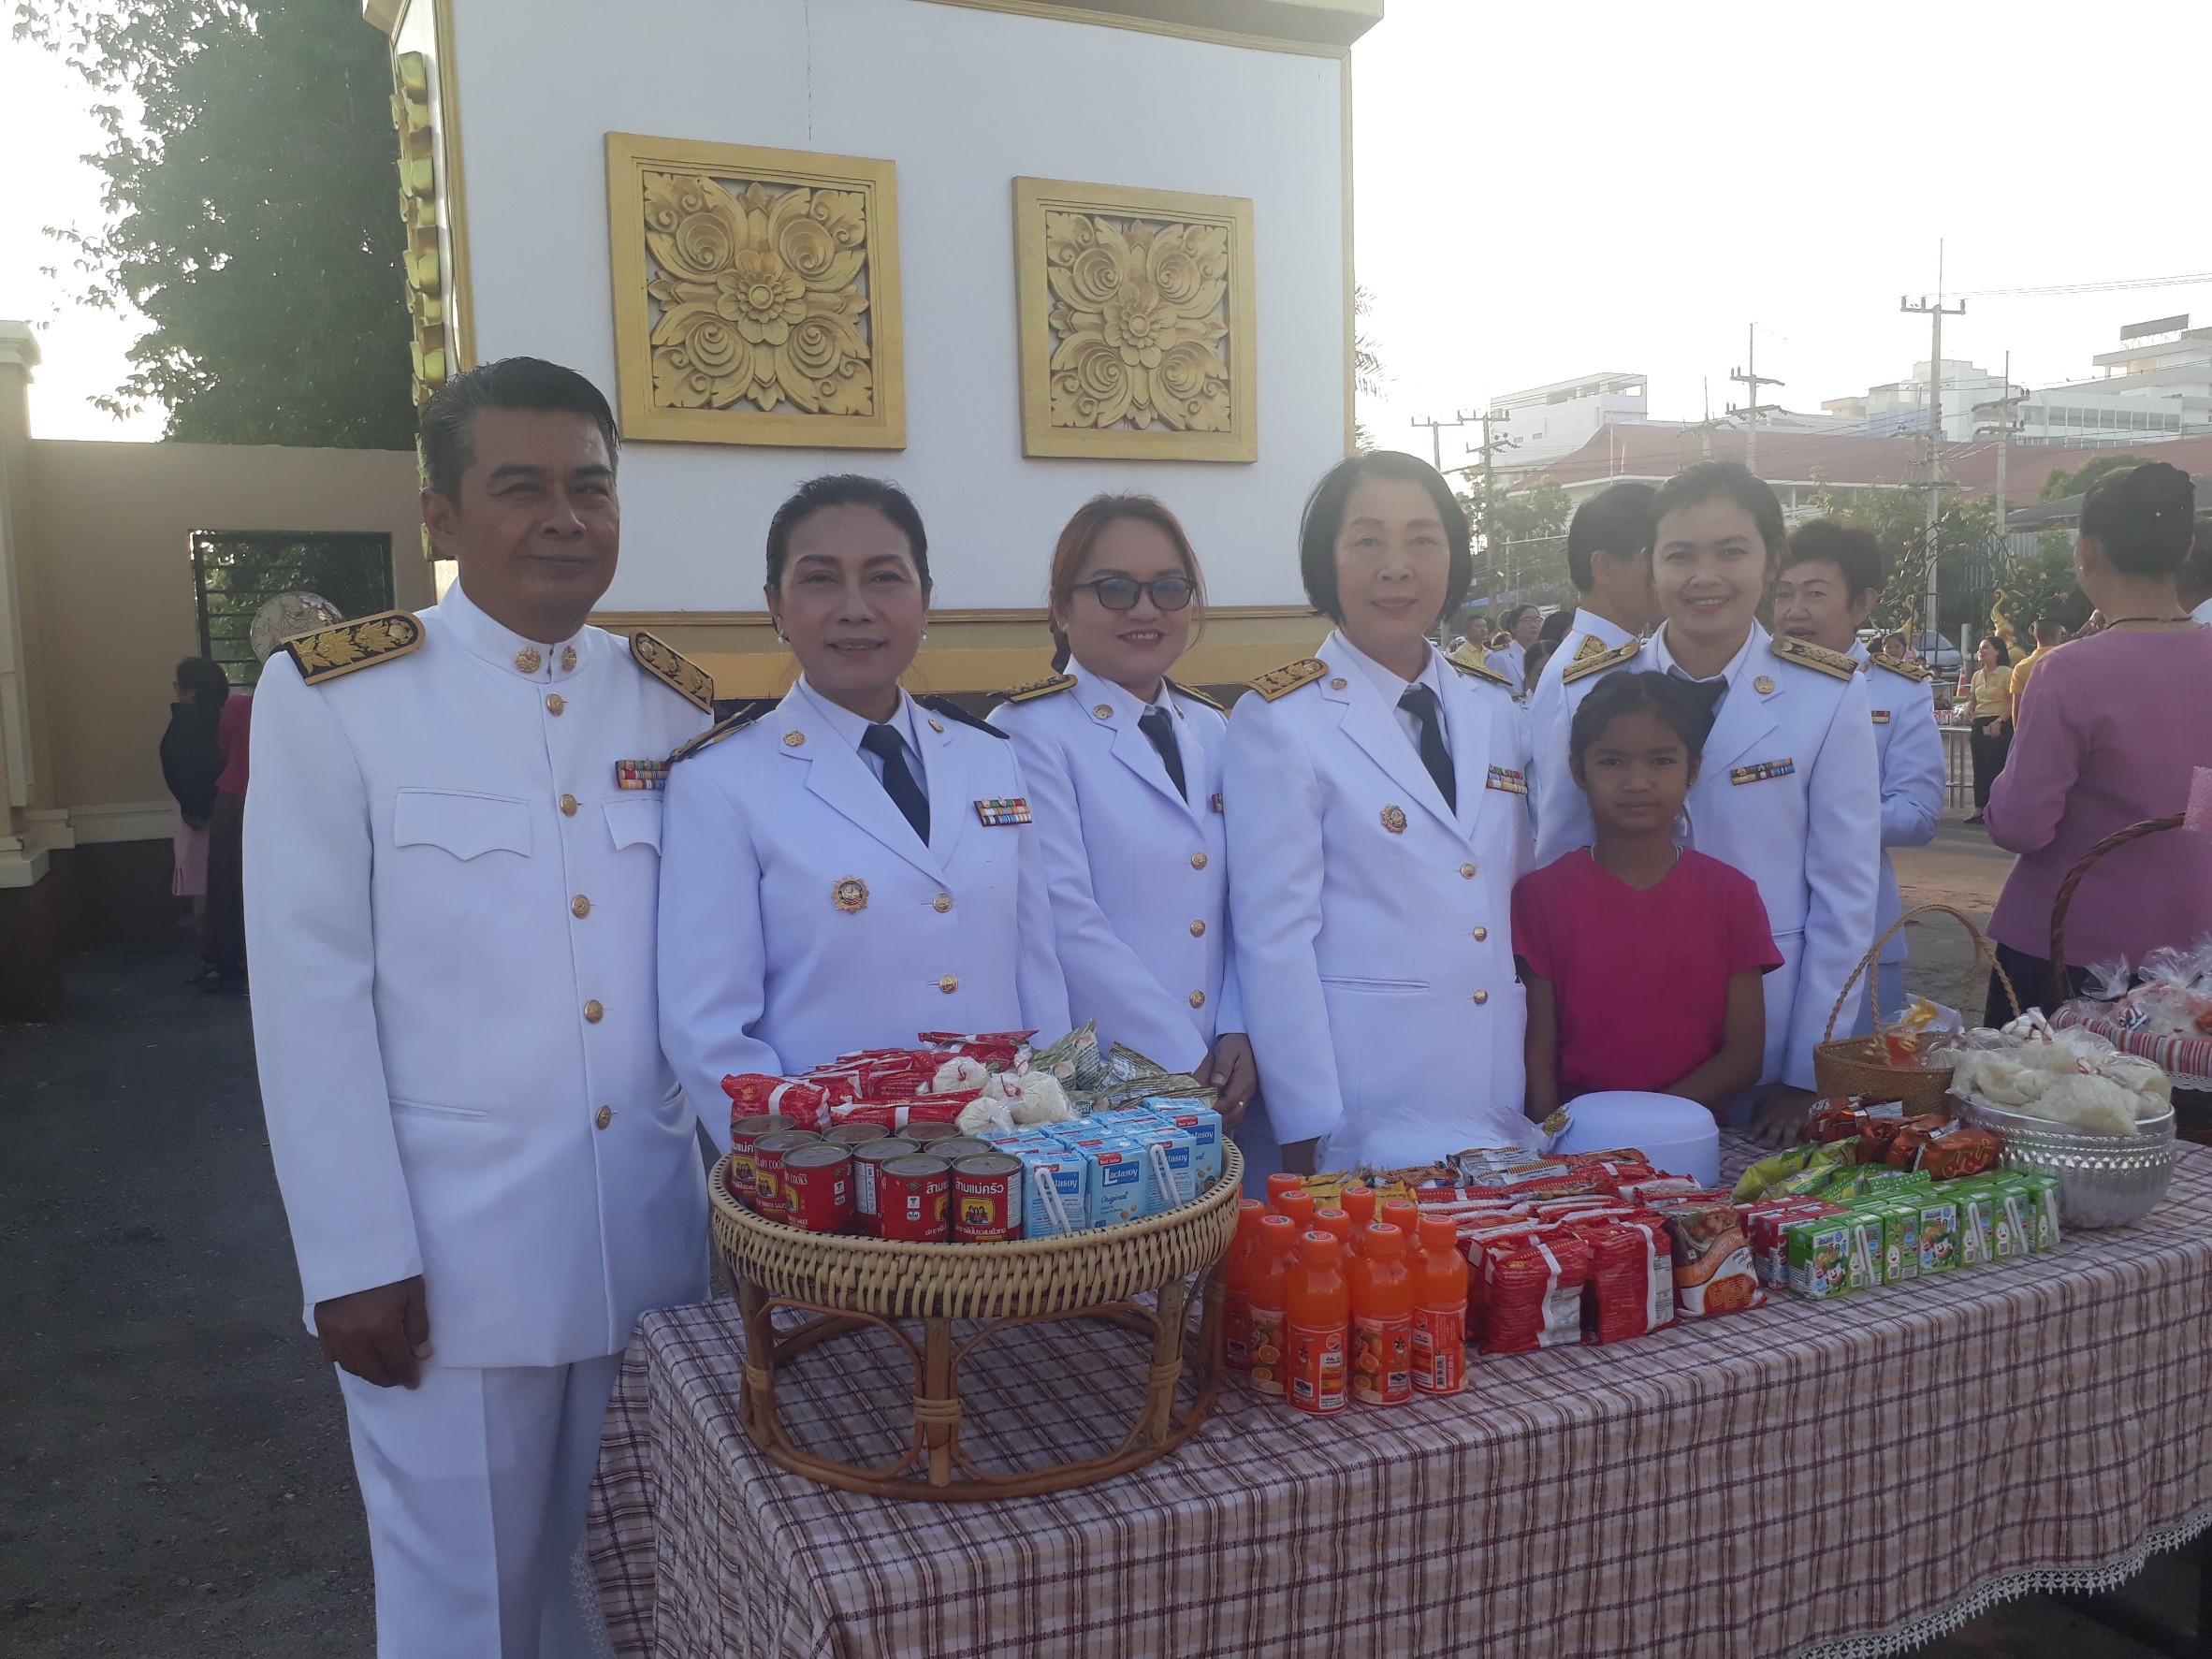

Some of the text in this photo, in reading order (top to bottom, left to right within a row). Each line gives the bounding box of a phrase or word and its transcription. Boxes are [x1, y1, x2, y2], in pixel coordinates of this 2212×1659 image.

[955, 1177, 1004, 1195] สามแม่ครัว
[1103, 1168, 1138, 1186] Lactasoy
[1100, 1191, 1129, 1205] Original
